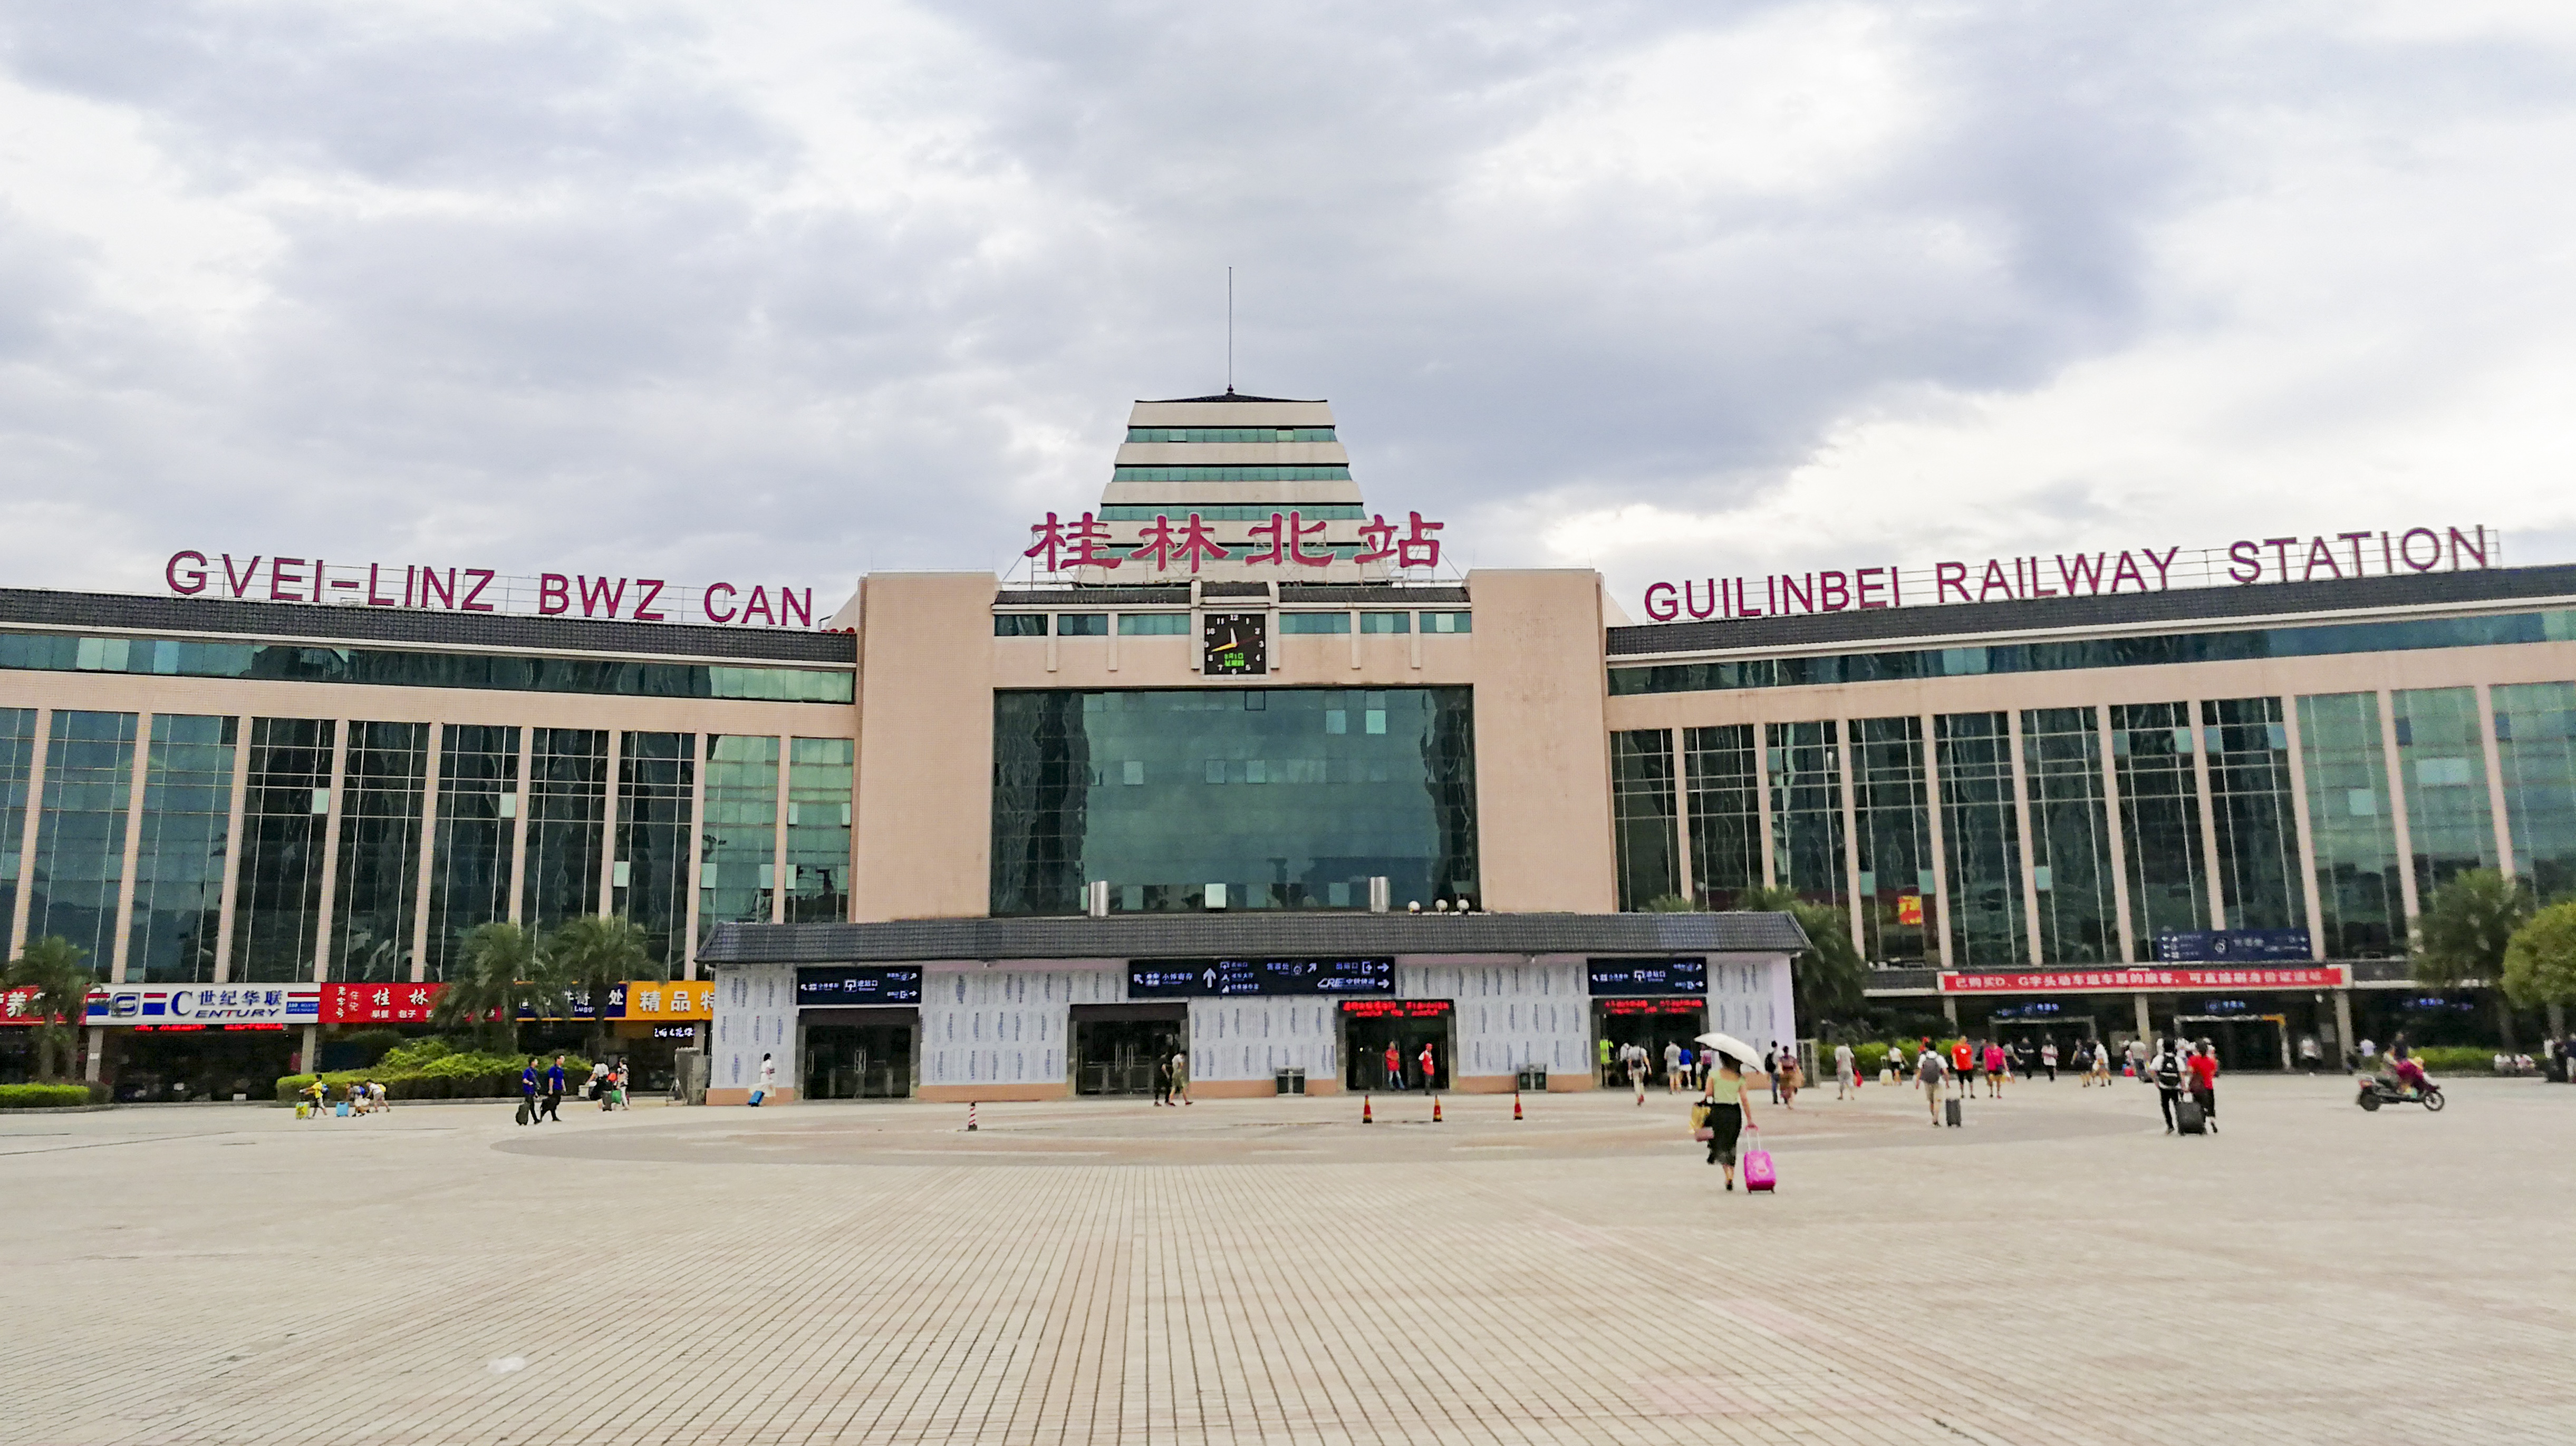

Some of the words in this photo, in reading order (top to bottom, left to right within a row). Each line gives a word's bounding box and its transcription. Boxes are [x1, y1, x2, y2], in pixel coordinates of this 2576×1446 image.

[1024, 510, 1444, 573] 桂林北站
[1644, 566, 1899, 622] GUILINBEI
[1935, 546, 2180, 603] RAILWAY
[2228, 525, 2486, 584] STATION
[166, 550, 495, 611] GVEI-LINZ
[539, 572, 664, 620] BWZ
[705, 582, 812, 626] CAN
[198, 989, 283, 1006] 世纪华联
